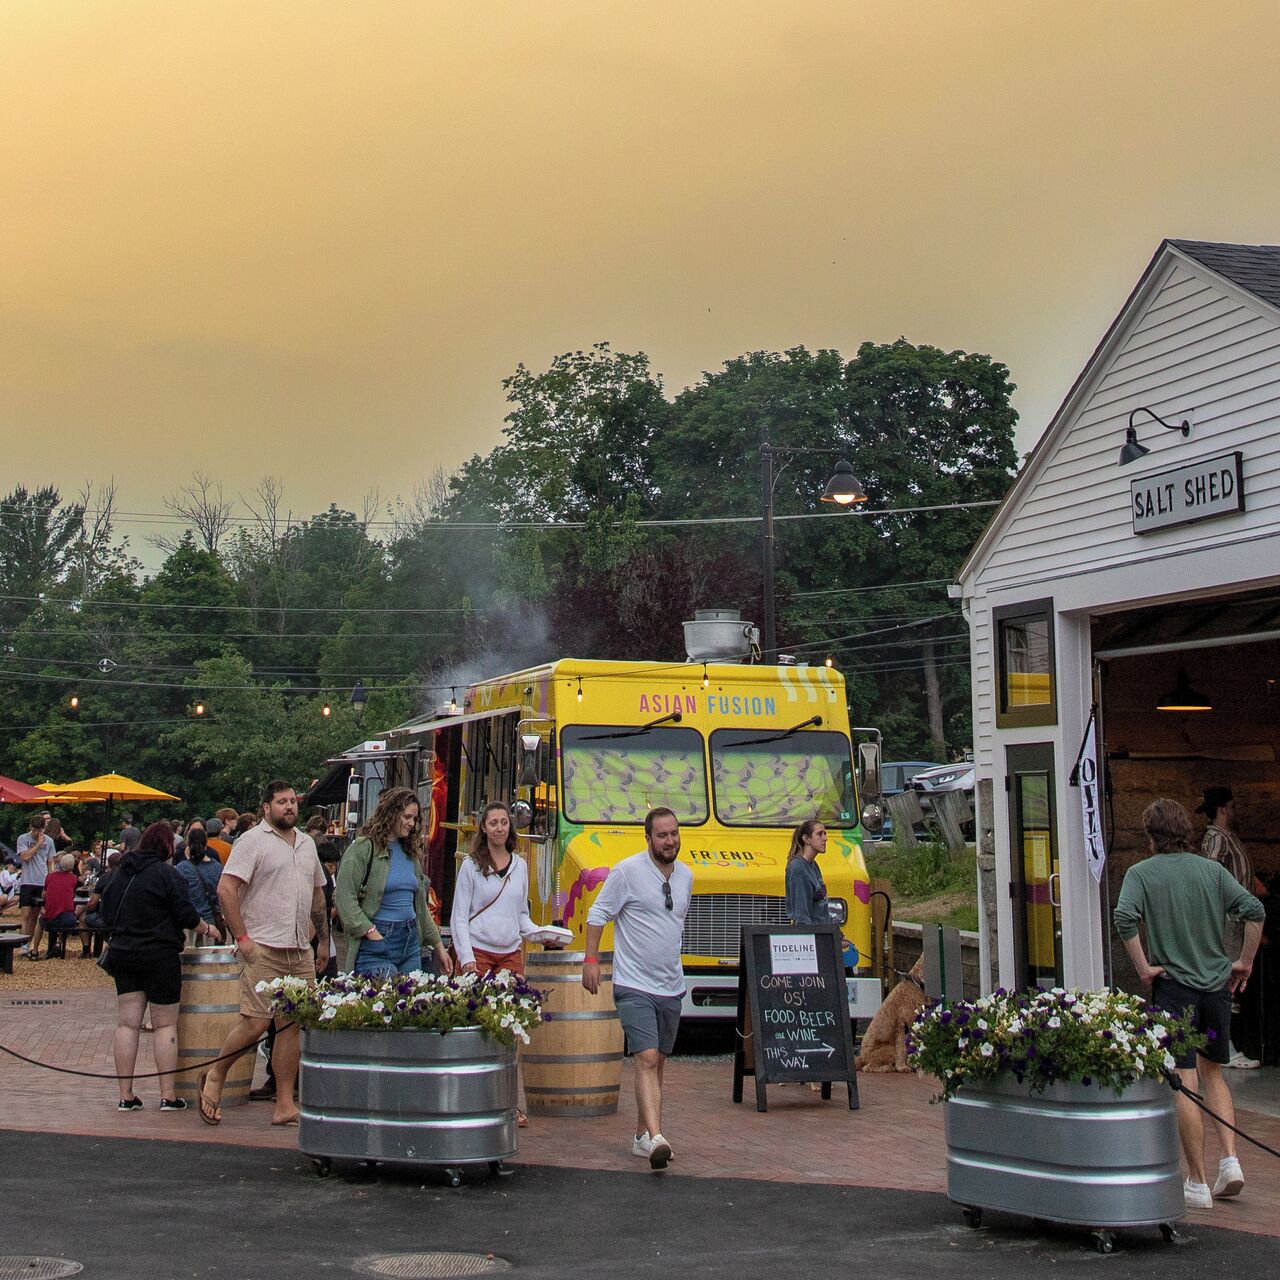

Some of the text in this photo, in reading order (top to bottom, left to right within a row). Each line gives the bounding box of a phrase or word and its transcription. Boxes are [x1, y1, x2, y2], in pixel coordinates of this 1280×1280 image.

[1134, 469, 1234, 519] SALT SHED
[639, 694, 776, 716] ASIAN FUSION
[773, 944, 815, 953] TIDELINE
[760, 975, 826, 989] COME JOIN
[784, 990, 807, 1007] US!
[799, 1010, 836, 1027] BEER
[786, 1028, 821, 1041] WINE
[764, 1047, 789, 1059] THIS
